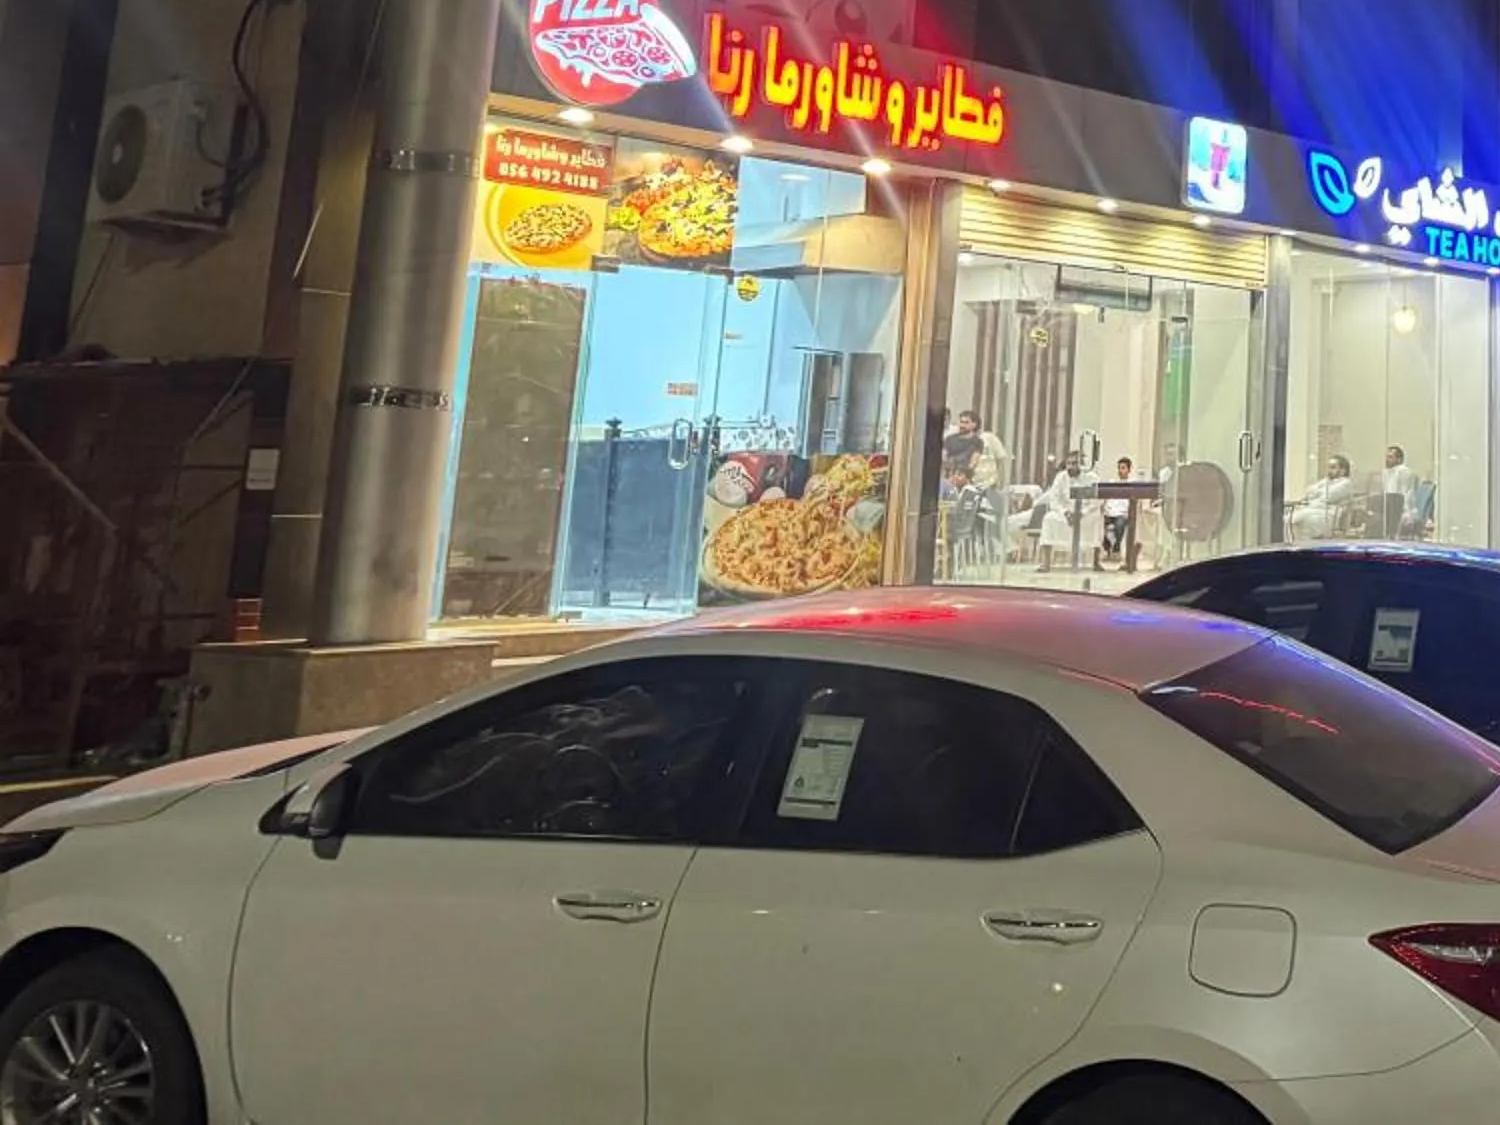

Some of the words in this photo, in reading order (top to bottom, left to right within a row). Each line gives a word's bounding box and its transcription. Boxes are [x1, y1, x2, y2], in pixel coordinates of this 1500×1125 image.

[707, 12, 755, 116] رنا
[907, 62, 1004, 152] فطاير
[498, 161, 528, 179] 056
[531, 165, 561, 184] 492
[1382, 167, 1489, 247] الشاي
[1425, 225, 1470, 262] TEA
